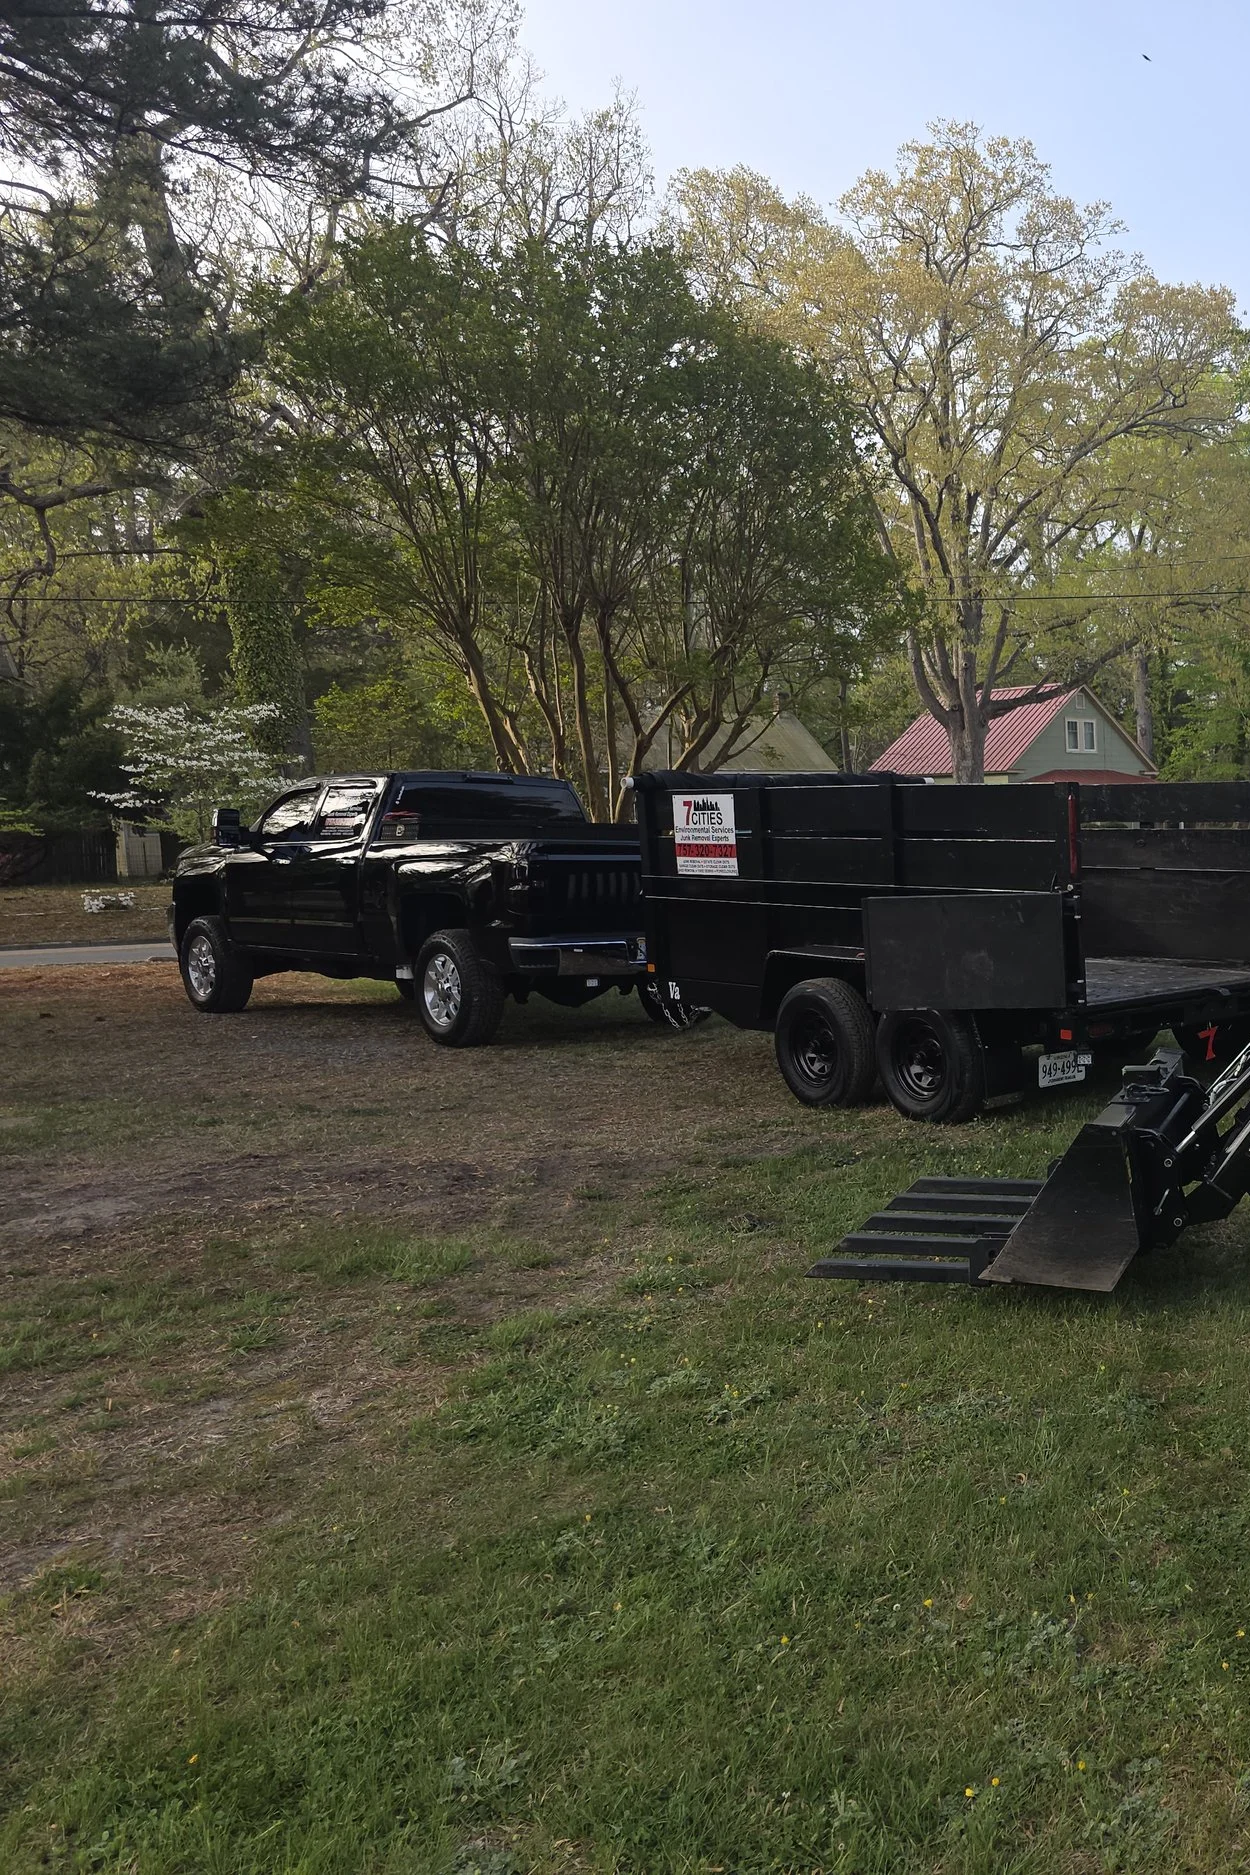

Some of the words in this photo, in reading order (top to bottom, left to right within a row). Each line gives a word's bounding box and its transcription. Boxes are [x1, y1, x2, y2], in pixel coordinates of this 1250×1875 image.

[683, 801, 693, 825] 7
[692, 812, 723, 825] CITIES
[675, 826, 710, 834] Environmental
[711, 826, 734, 834] Services
[677, 844, 733, 857] 757-320-7327
[668, 982, 680, 1000] Va
